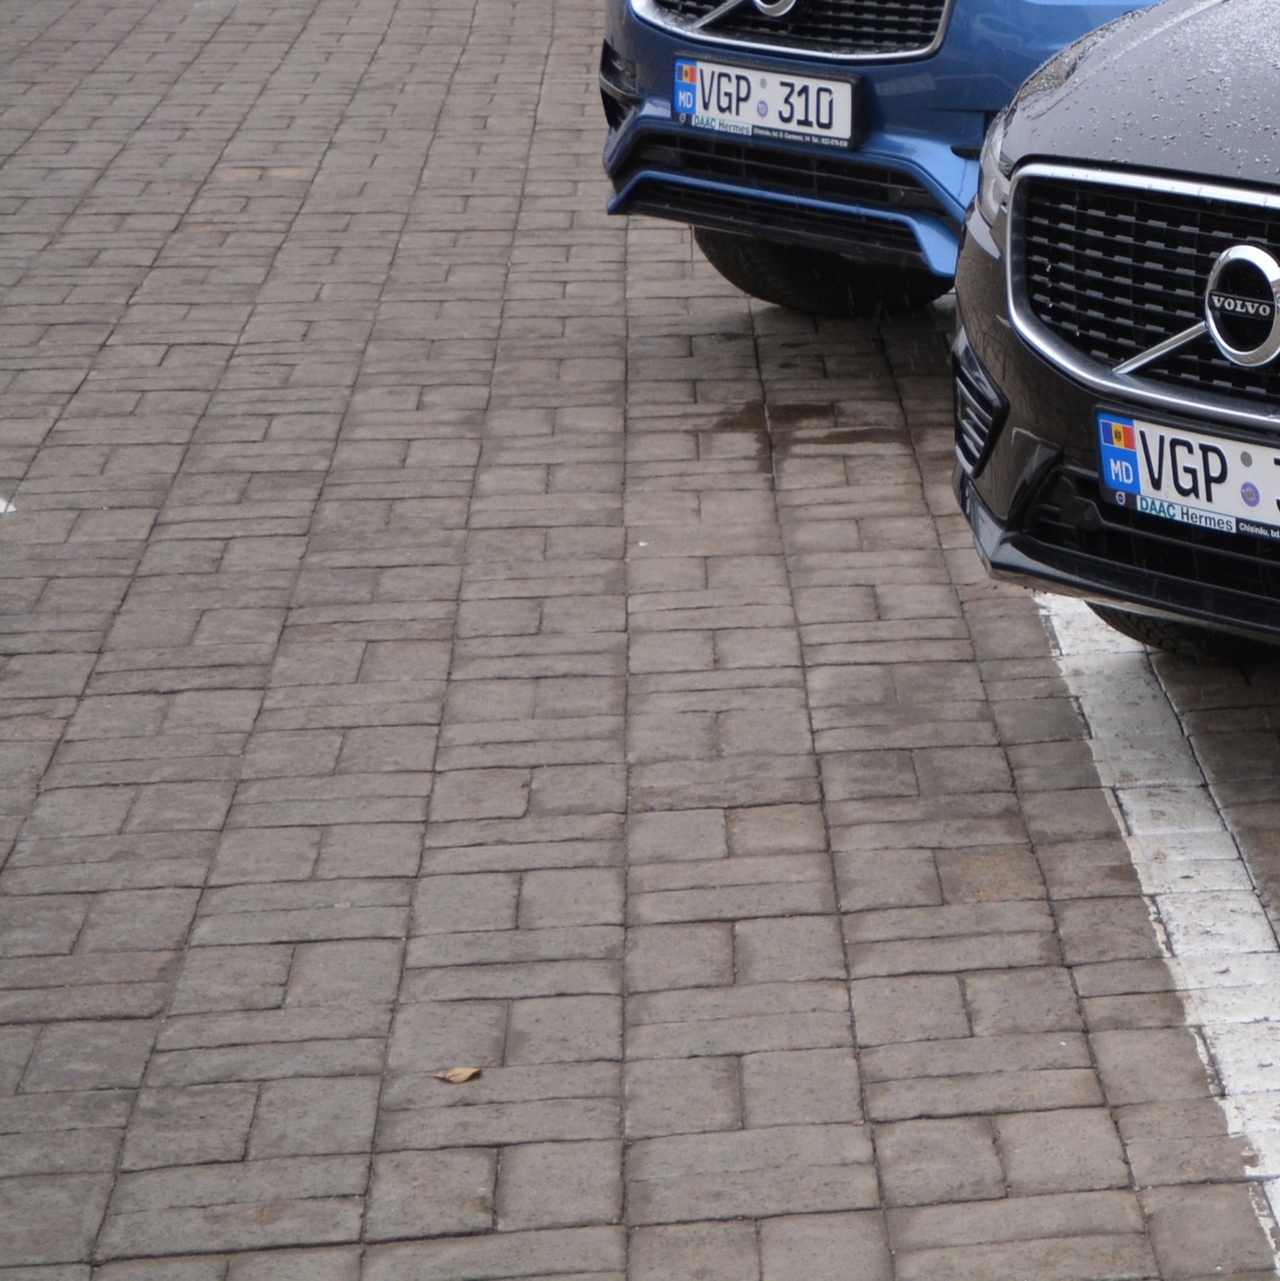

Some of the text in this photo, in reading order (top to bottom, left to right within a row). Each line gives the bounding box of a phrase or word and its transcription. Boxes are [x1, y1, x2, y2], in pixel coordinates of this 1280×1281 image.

[678, 90, 693, 109] MD
[699, 68, 834, 130] VGP 310
[693, 115, 750, 135] DAAC Hermes
[1211, 295, 1271, 317] VOLVO
[1108, 458, 1134, 485] MD
[1138, 428, 1229, 504] VGP
[1139, 497, 1234, 532] DAAC Hermes
